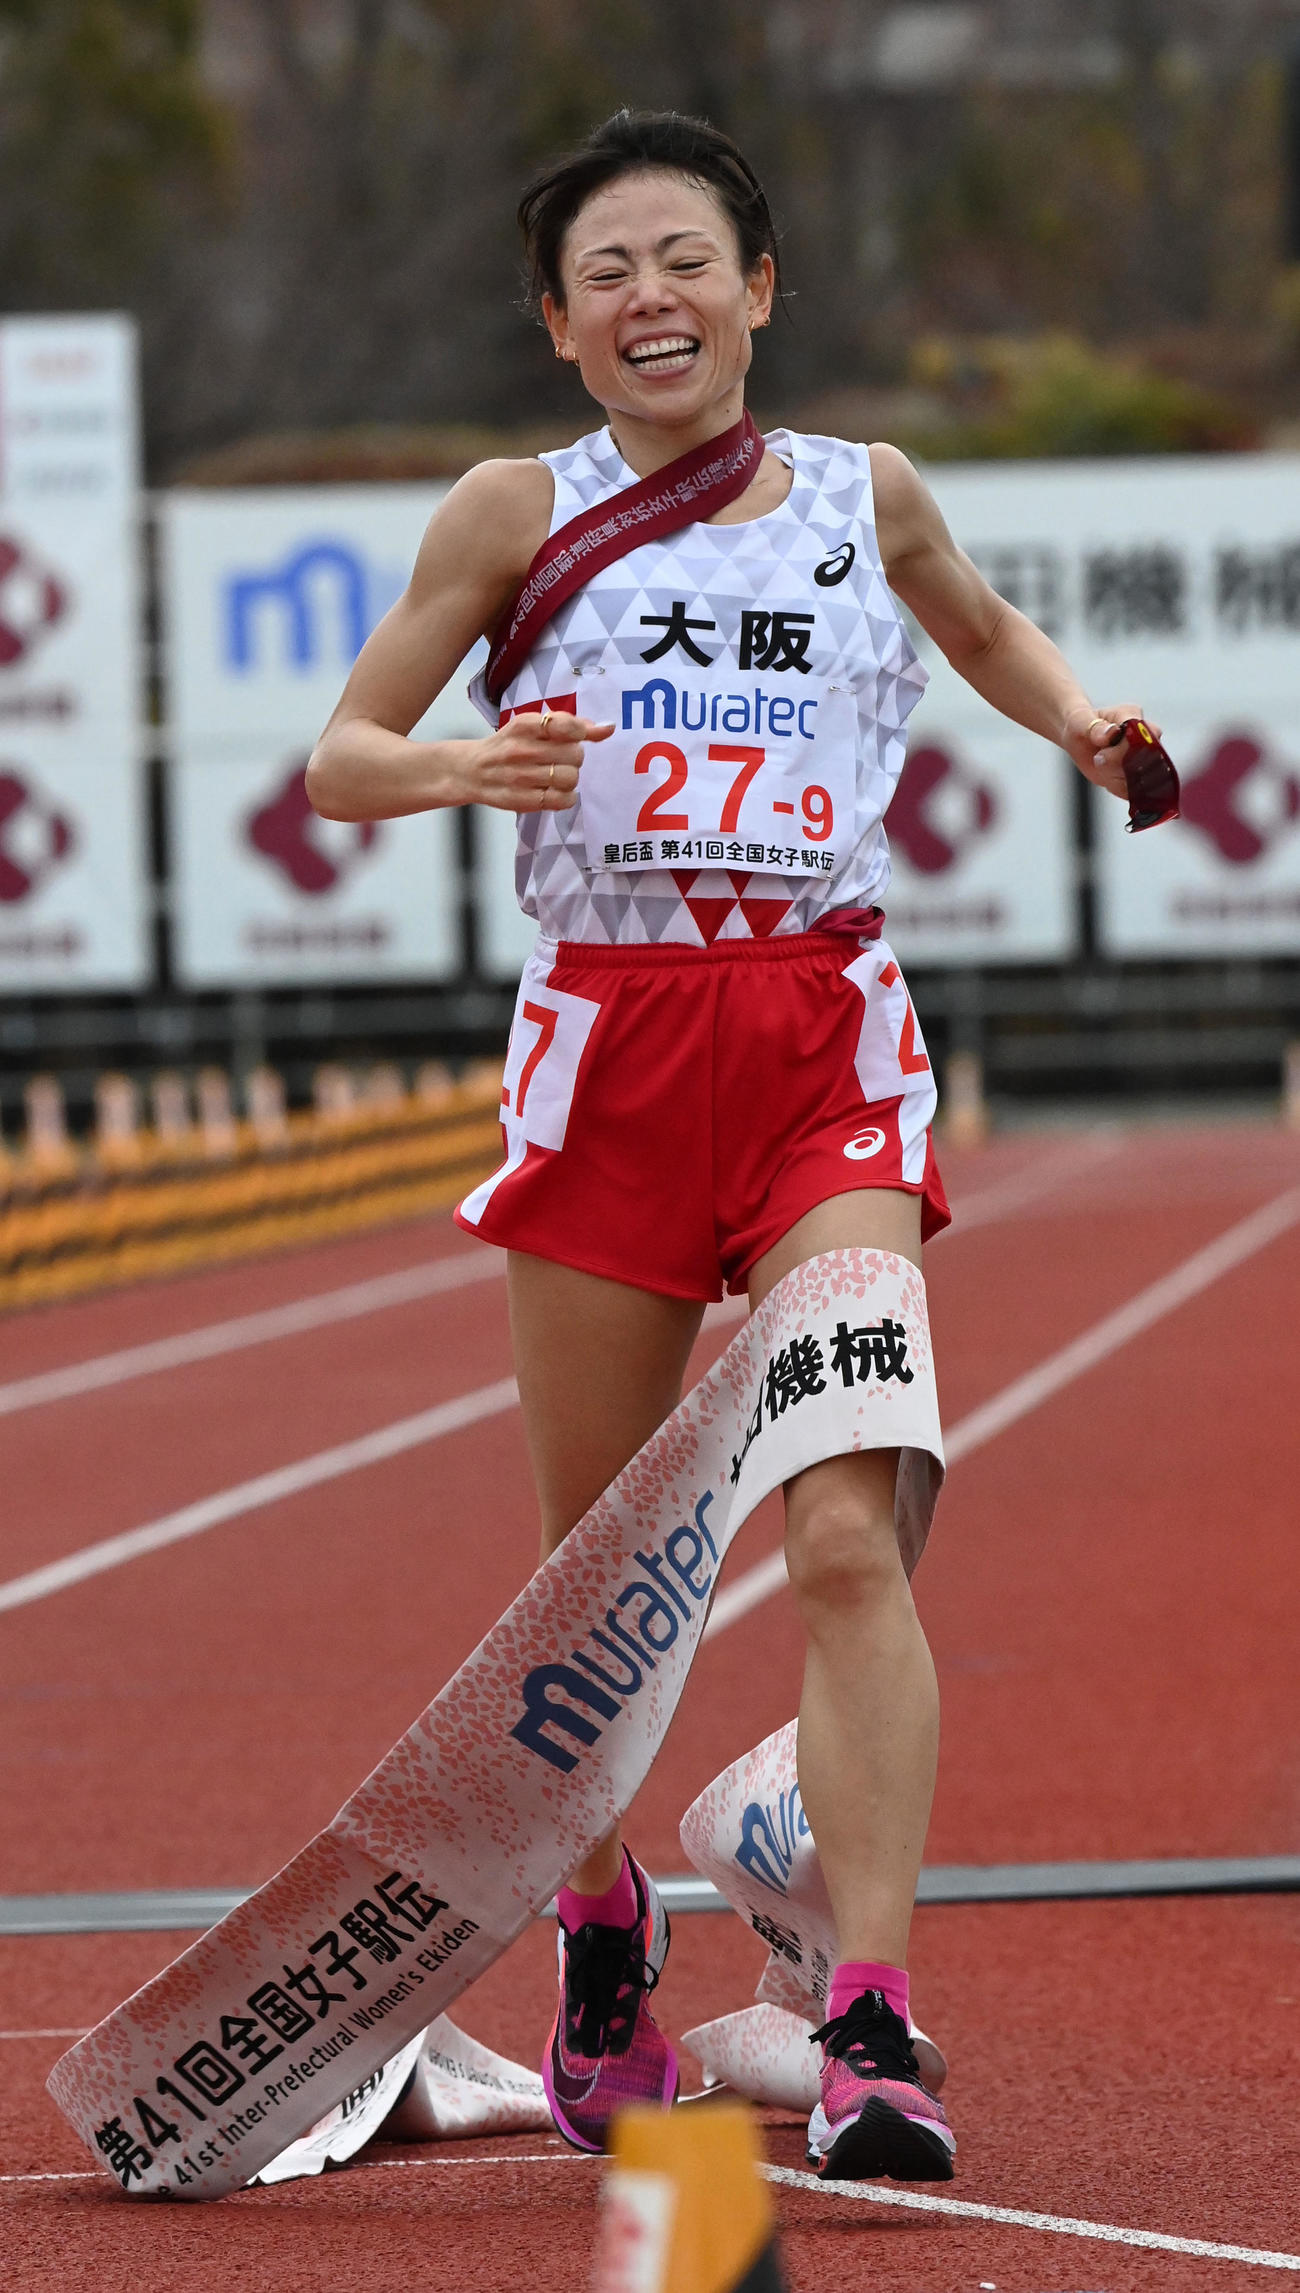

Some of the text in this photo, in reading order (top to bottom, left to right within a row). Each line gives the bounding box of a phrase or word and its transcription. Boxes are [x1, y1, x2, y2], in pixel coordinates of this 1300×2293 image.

[640, 601, 815, 675] 大阪
[622, 678, 818, 740] muratec
[604, 840, 835, 872] 皇后盃 第41回全国女子駅伝
[501, 1000, 559, 1118] 7
[729, 1317, 915, 1486] 機械
[94, 1872, 449, 2189] 第41回全国女子駅伝
[174, 2139, 224, 2185] 41st
[217, 2023, 358, 2146] Inter-Prefectural
[351, 1969, 424, 2031] Women's
[416, 1918, 481, 1973] Ekiden
